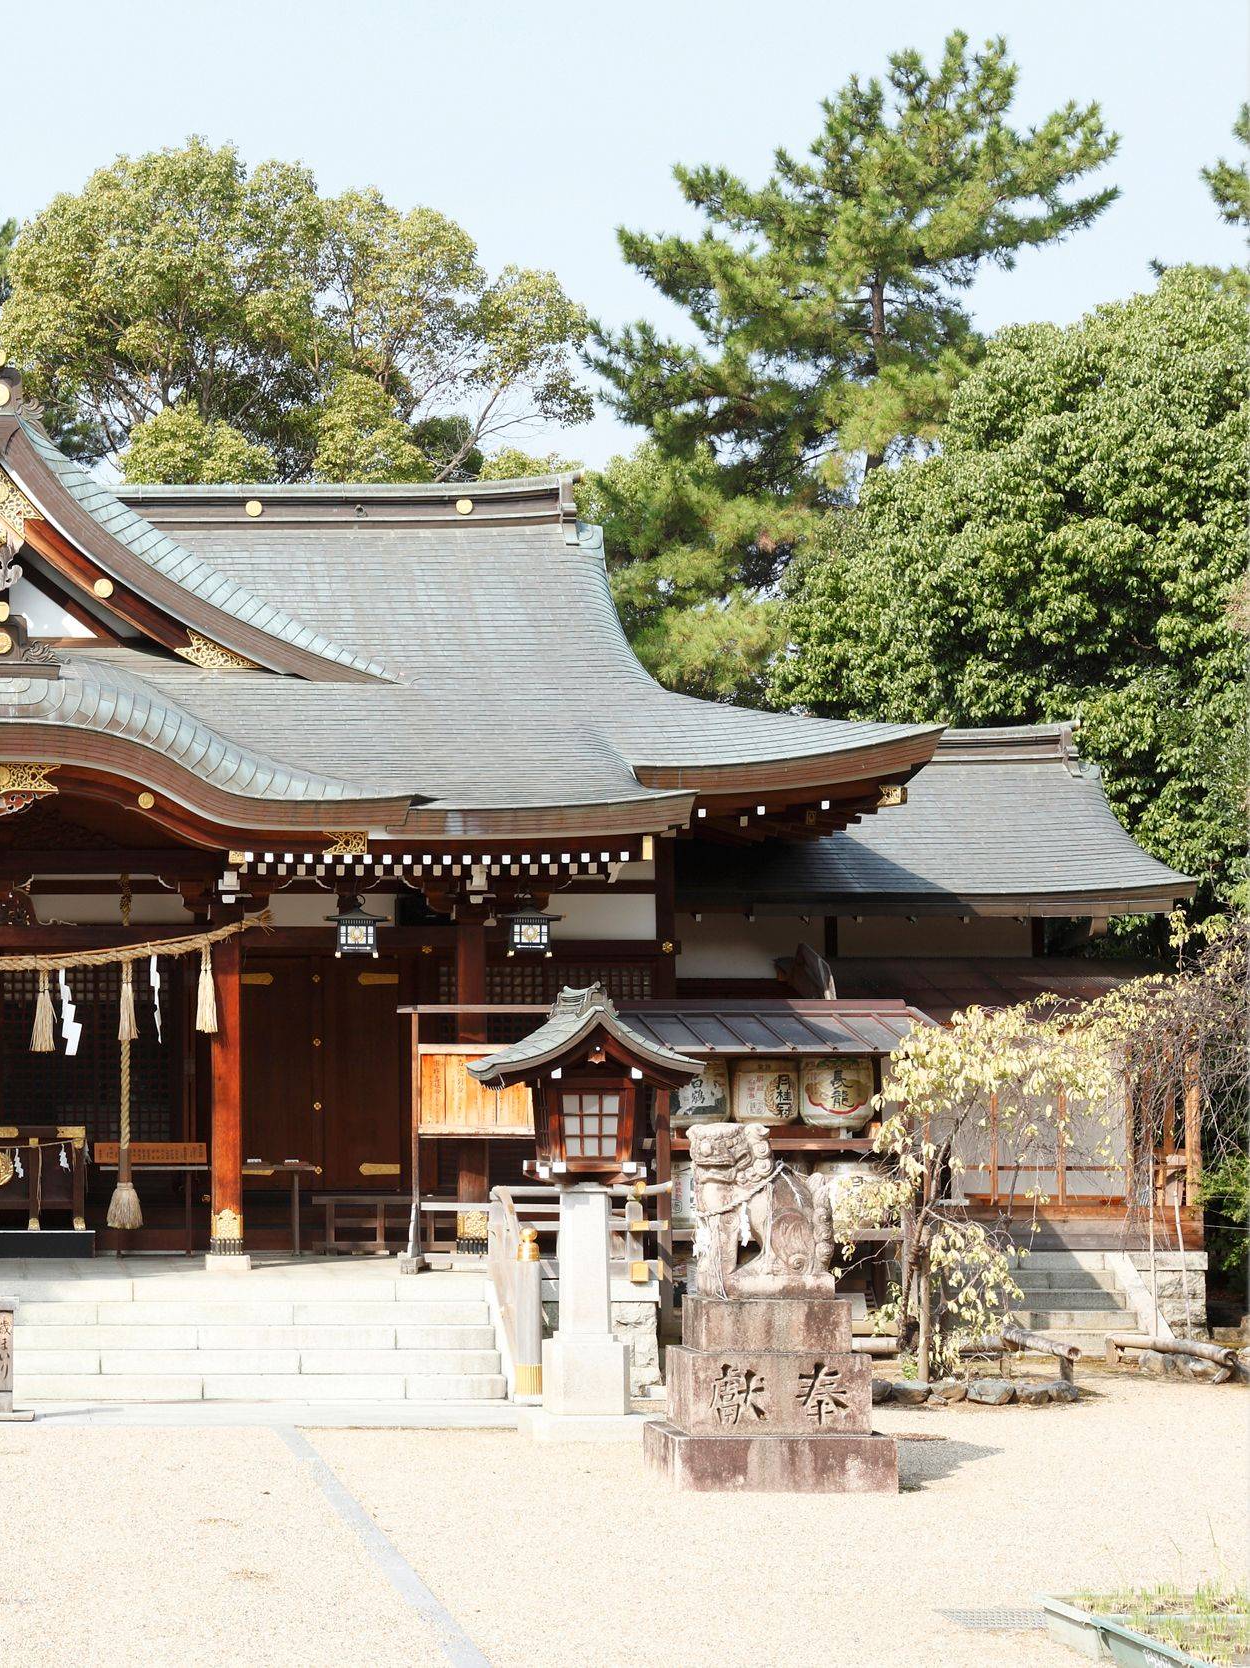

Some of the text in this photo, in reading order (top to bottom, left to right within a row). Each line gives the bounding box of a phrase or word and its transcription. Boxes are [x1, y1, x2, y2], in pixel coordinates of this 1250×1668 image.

[776, 1073, 793, 1118] 月桂冠
[830, 1069, 854, 1109] 長龍
